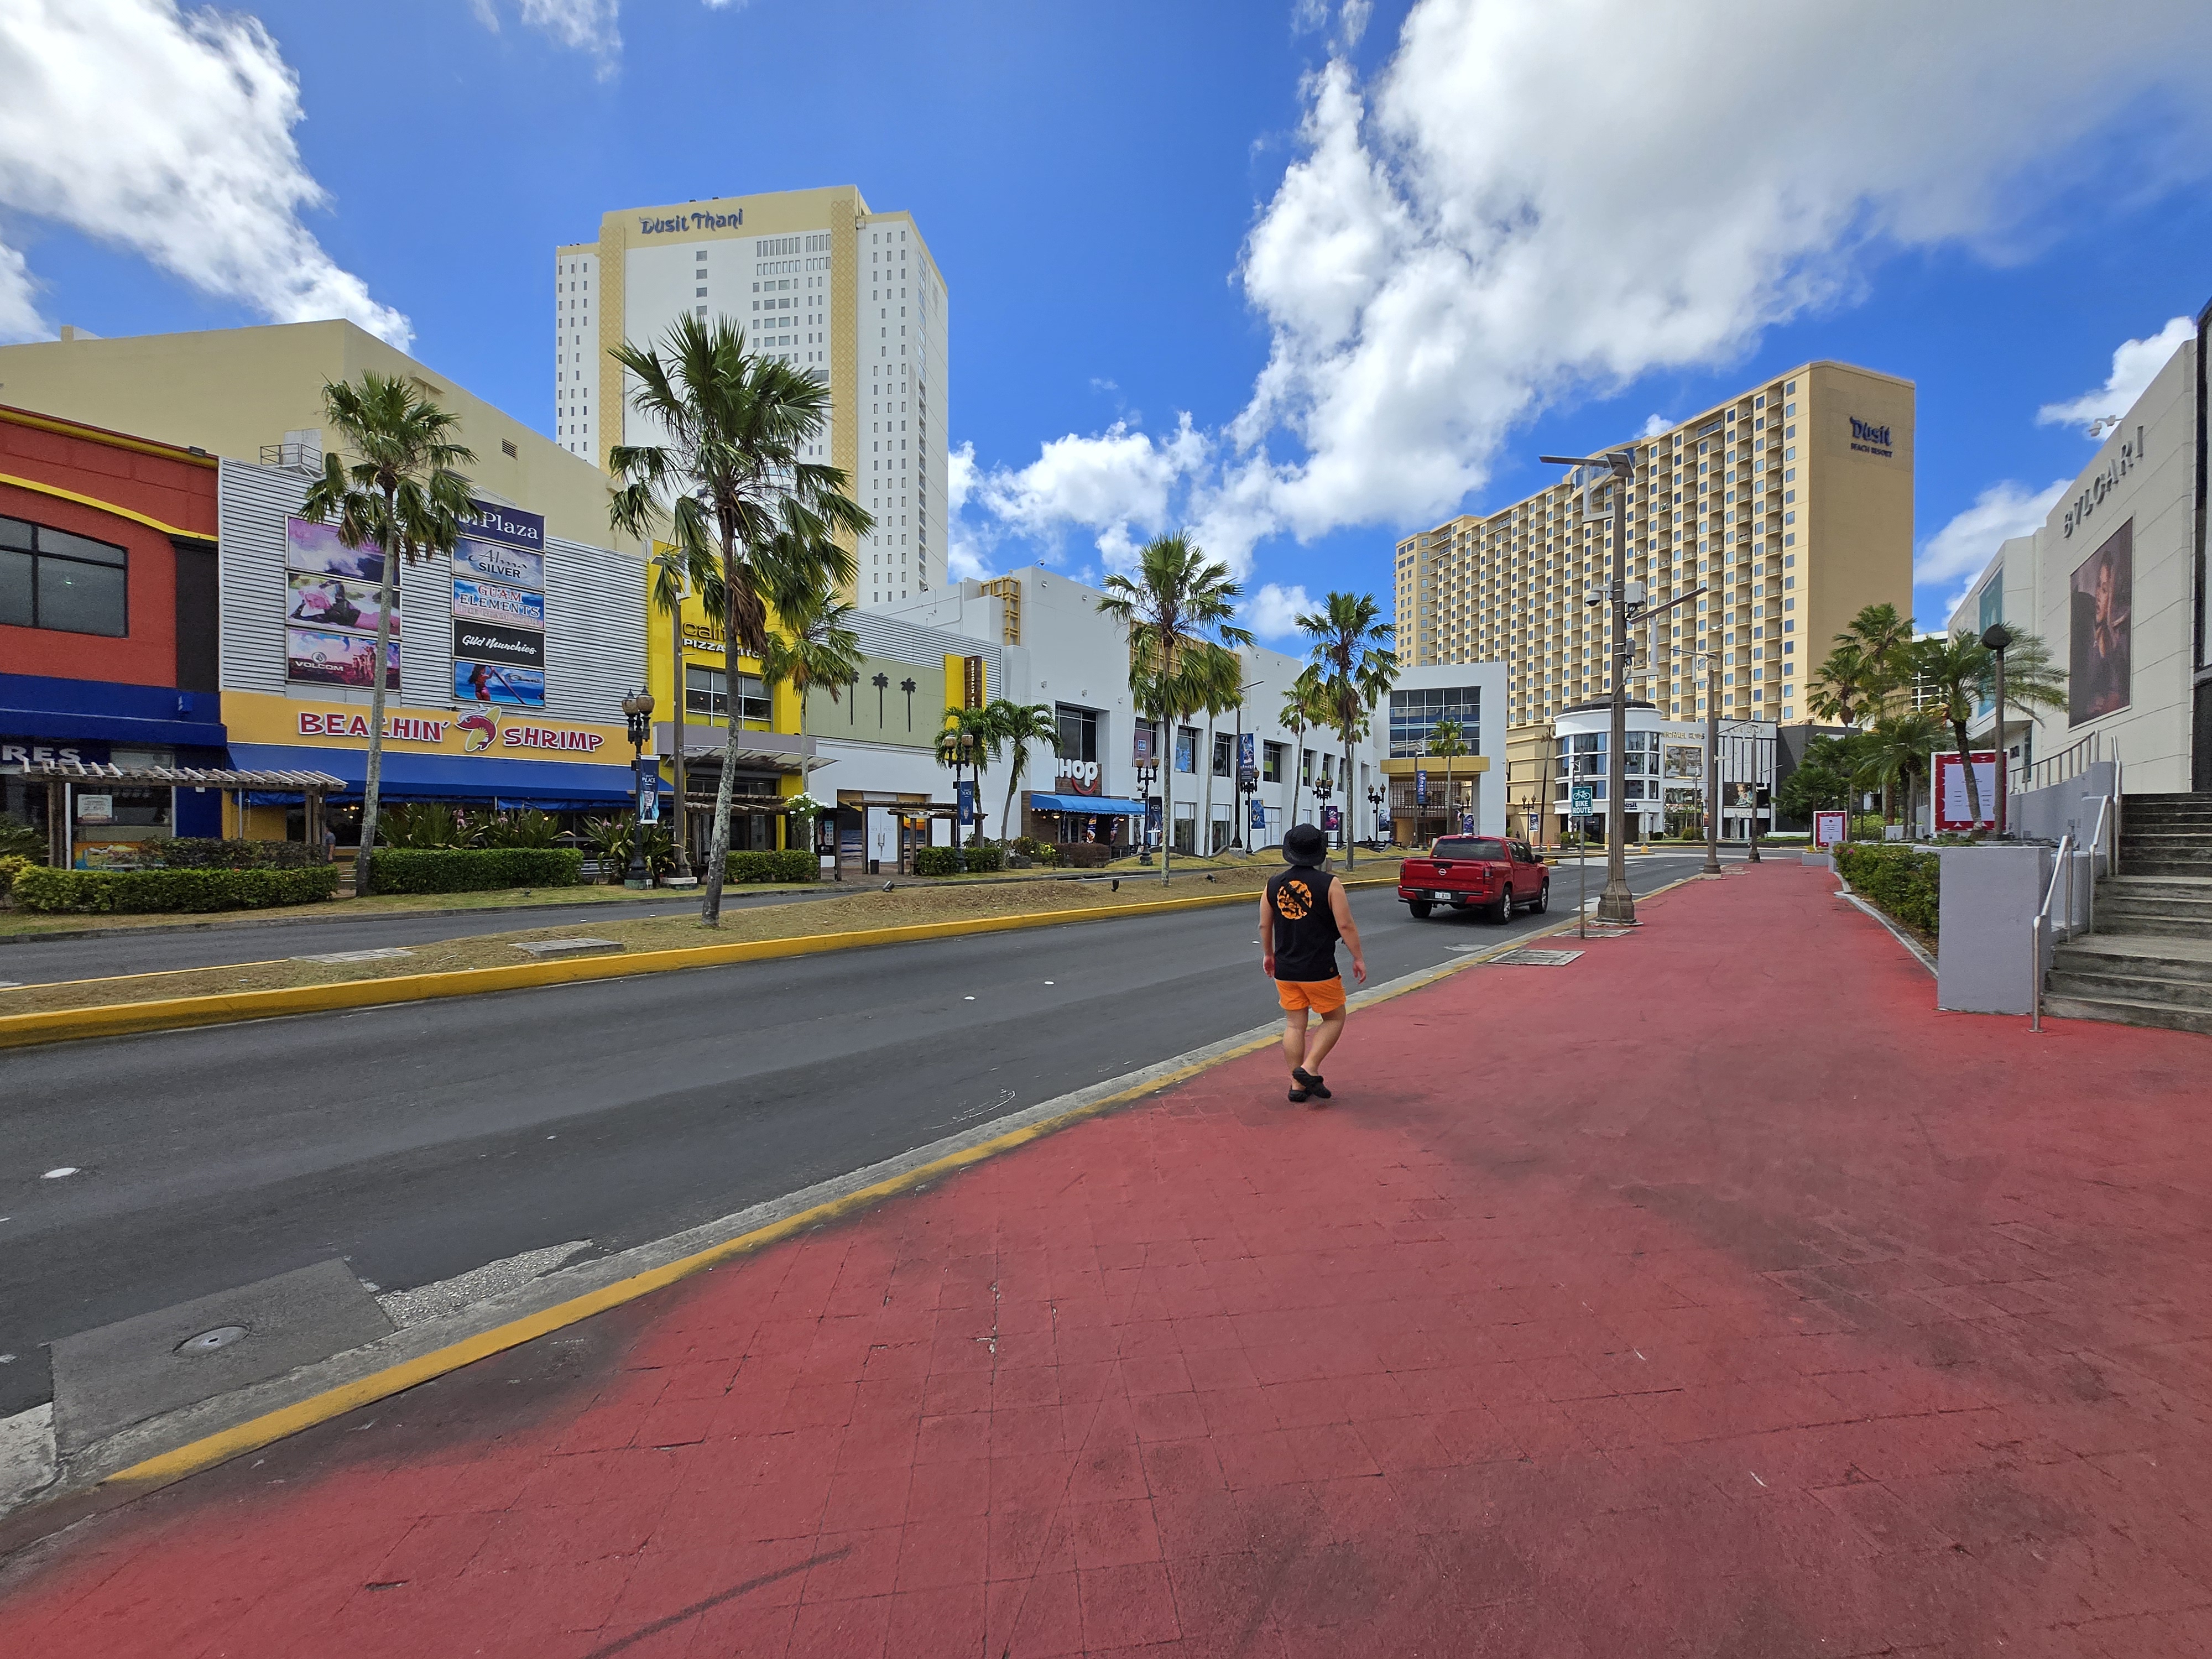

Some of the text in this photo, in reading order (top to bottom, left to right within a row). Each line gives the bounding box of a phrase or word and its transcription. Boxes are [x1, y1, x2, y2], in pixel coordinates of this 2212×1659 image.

[639, 208, 743, 234] Dusit Thani
[1849, 416, 1892, 446] Dusit
[1851, 442, 1893, 458] BEACH RESORT
[2063, 425, 2144, 539] BVLGARI
[480, 511, 539, 540] Plaza
[479, 562, 521, 578] SILVER
[460, 594, 540, 618] ELEMENTS
[478, 585, 522, 603] GUAM
[684, 638, 726, 653] PIZZA
[295, 661, 343, 671] VOLCOM
[503, 727, 605, 752] SHRIMP
